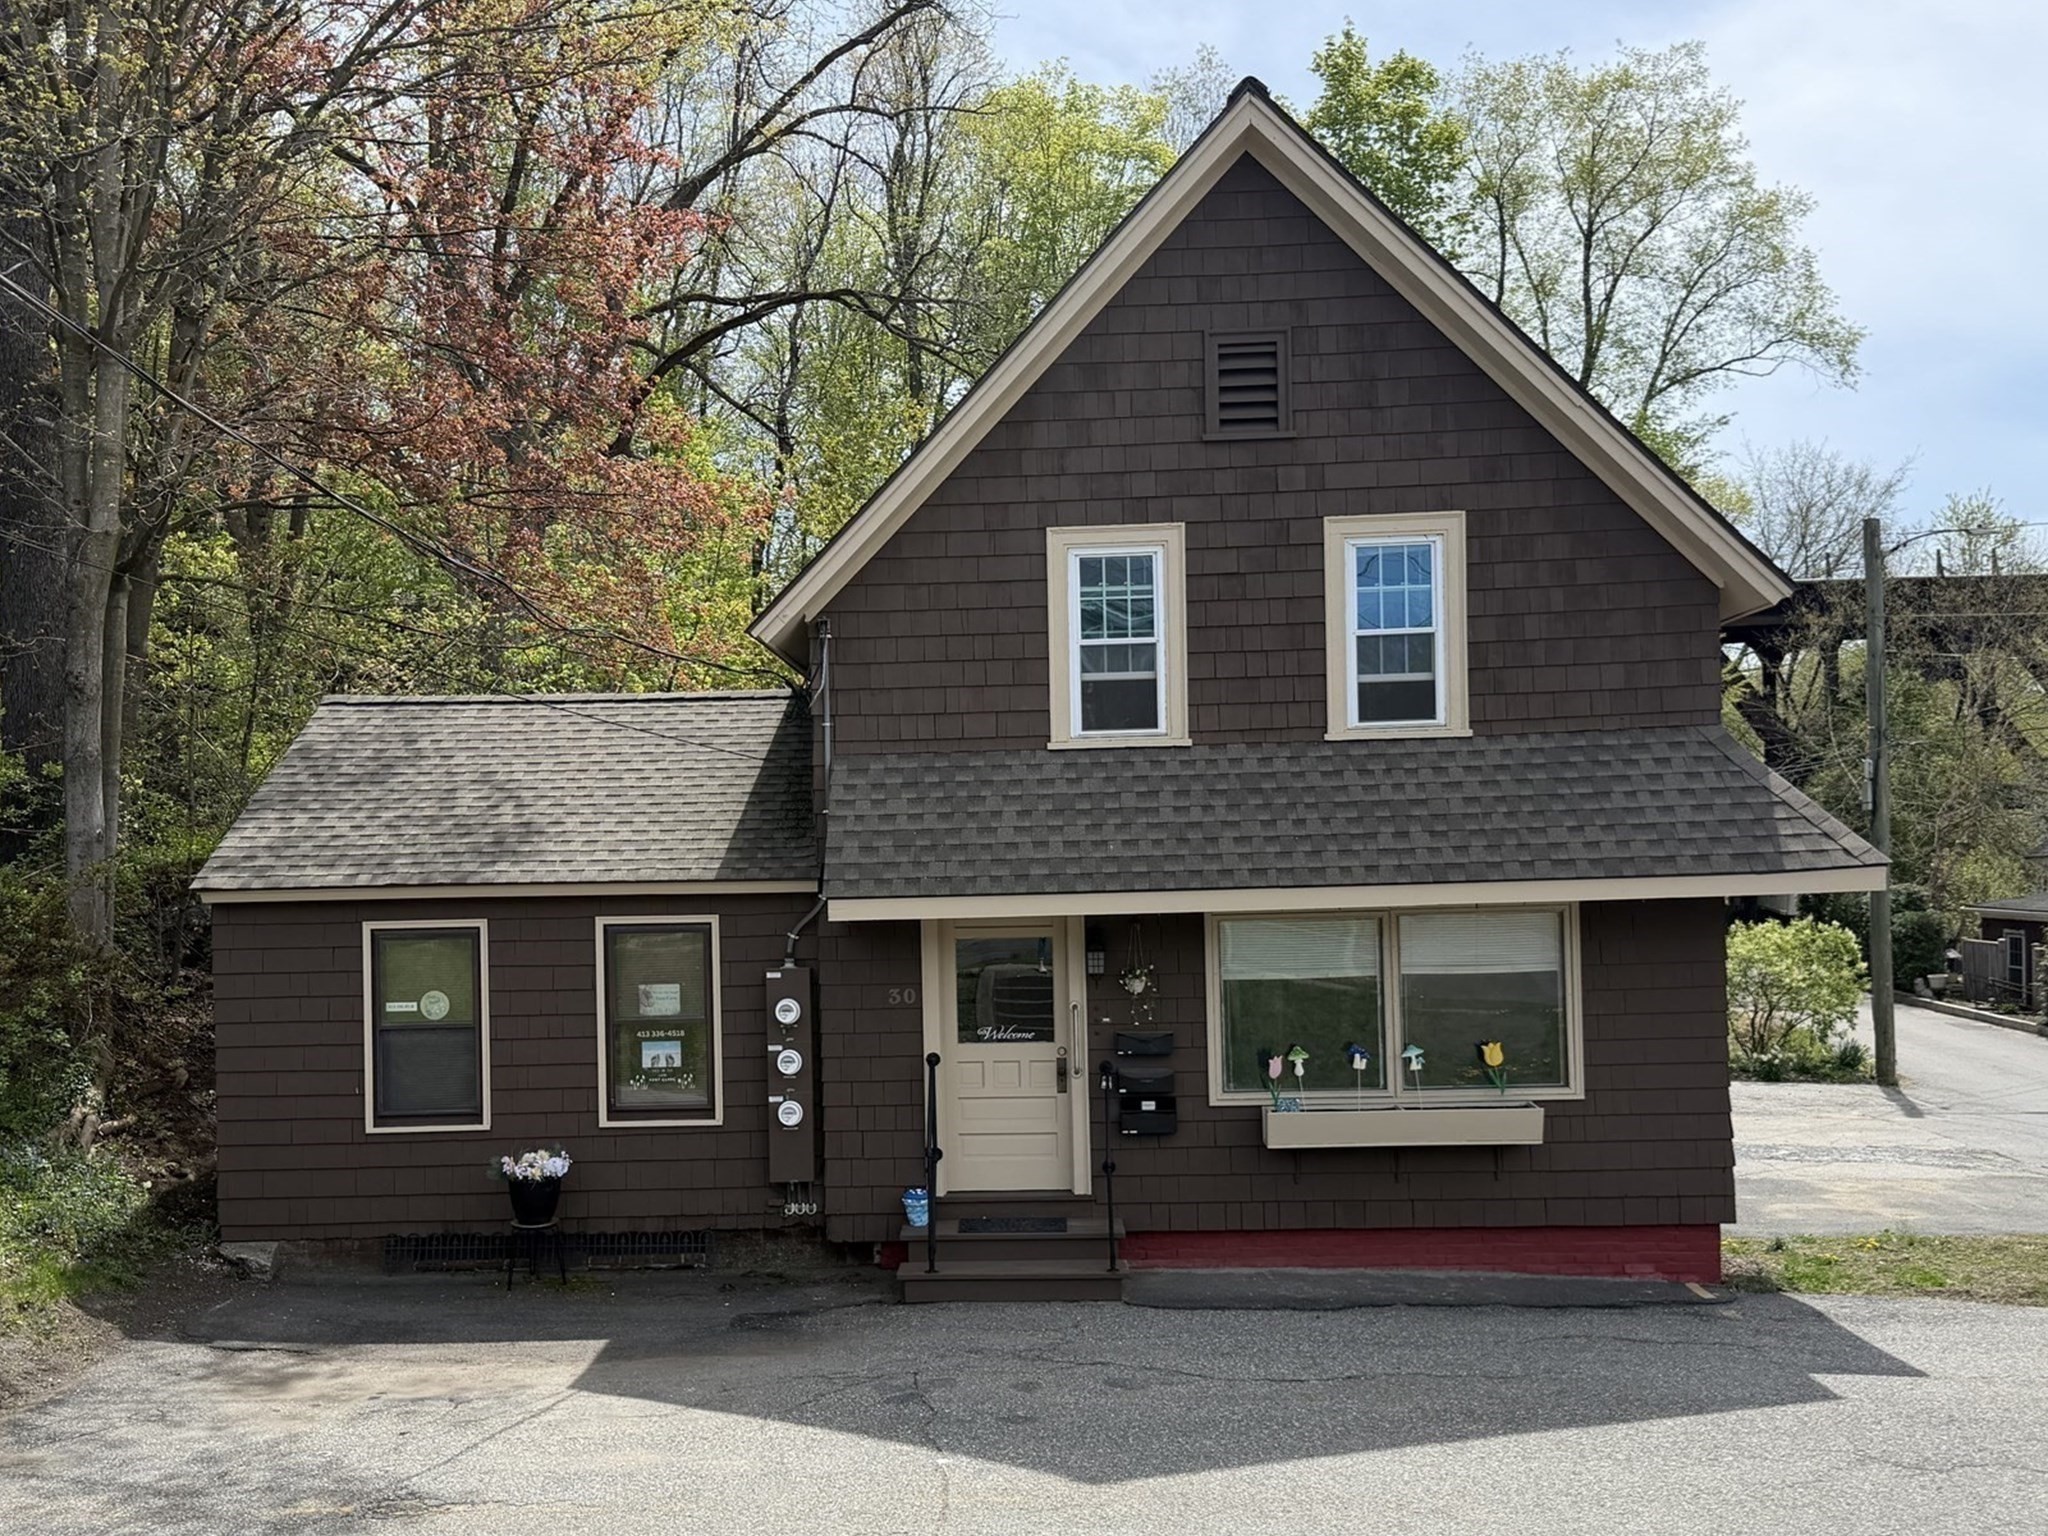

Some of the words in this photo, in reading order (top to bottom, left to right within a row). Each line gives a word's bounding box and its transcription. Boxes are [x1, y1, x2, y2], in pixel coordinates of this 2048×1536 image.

[888, 988, 916, 1005] 30
[636, 1030, 650, 1038] 413
[976, 1024, 1036, 1040] Welcome
